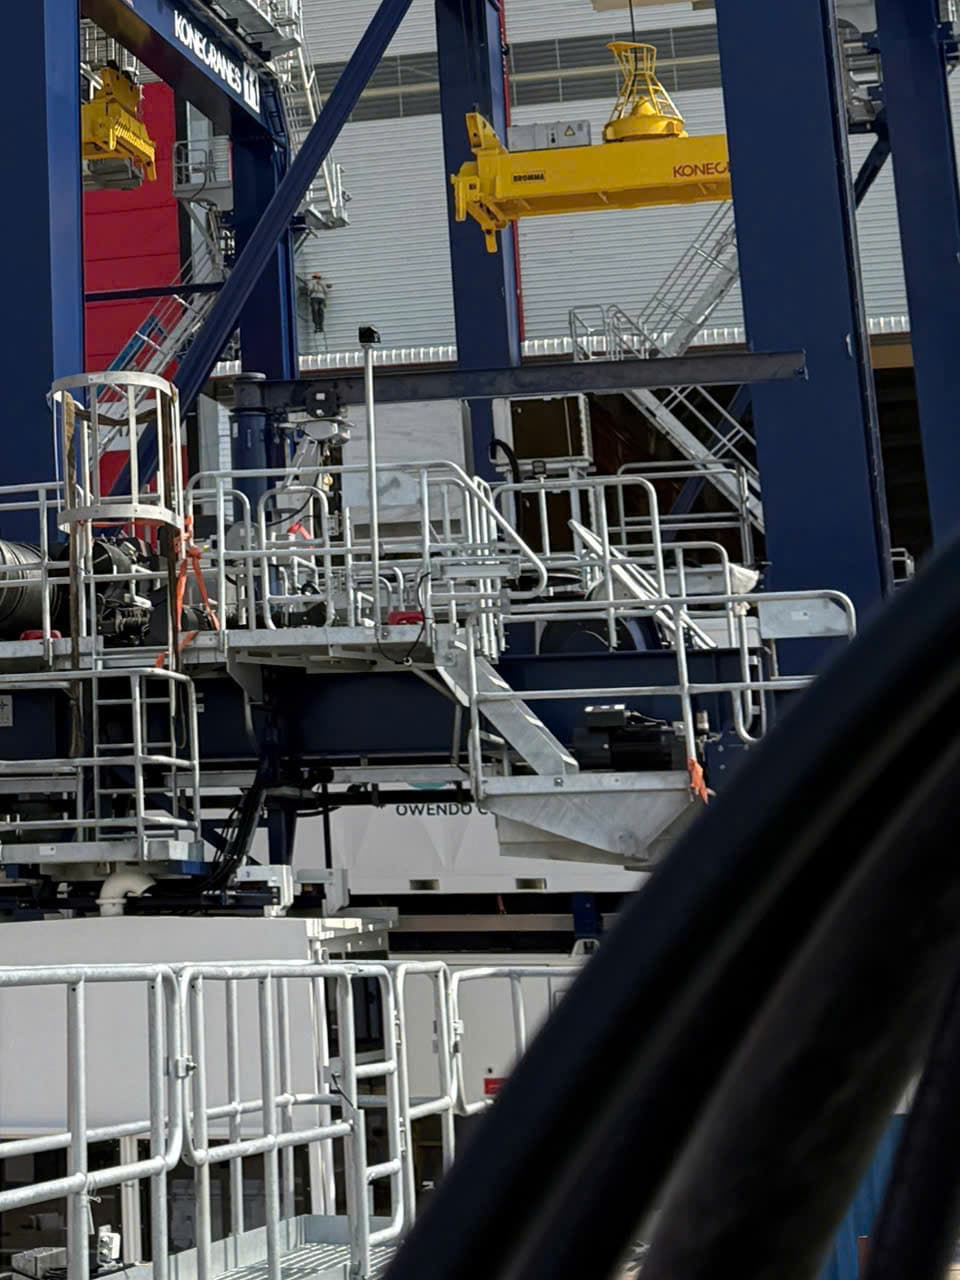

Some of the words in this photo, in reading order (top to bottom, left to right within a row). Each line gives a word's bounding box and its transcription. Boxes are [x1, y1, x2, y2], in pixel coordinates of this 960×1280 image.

[173, 9, 242, 94] KONECRANES
[673, 161, 730, 178] KONEC
[395, 803, 473, 817] OWENDO
